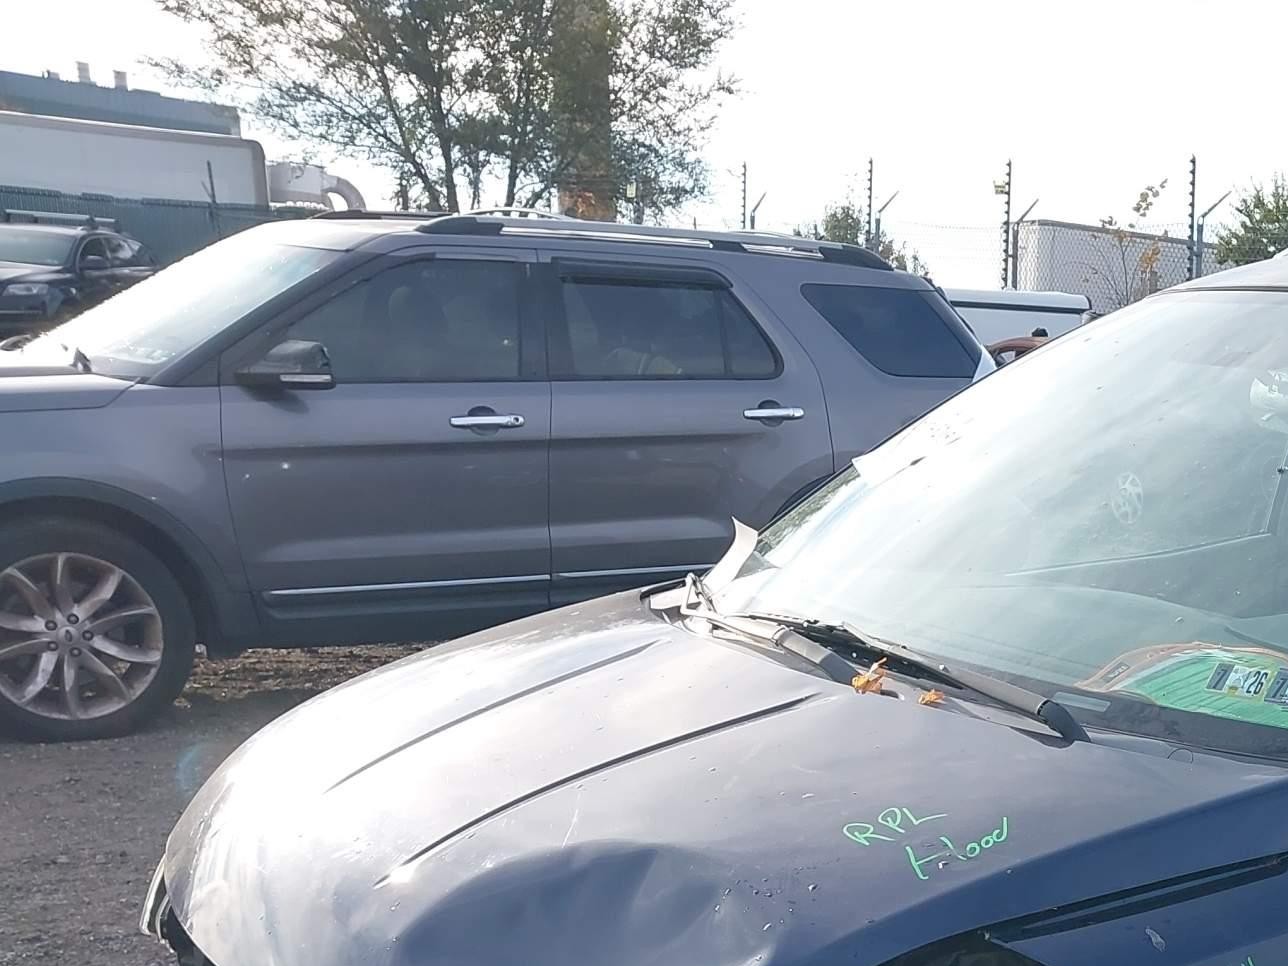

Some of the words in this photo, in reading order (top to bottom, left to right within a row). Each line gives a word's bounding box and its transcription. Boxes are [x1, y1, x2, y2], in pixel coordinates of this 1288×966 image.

[1246, 670, 1269, 696] 26
[842, 807, 949, 846] RPL
[905, 816, 1008, 880] Hood
